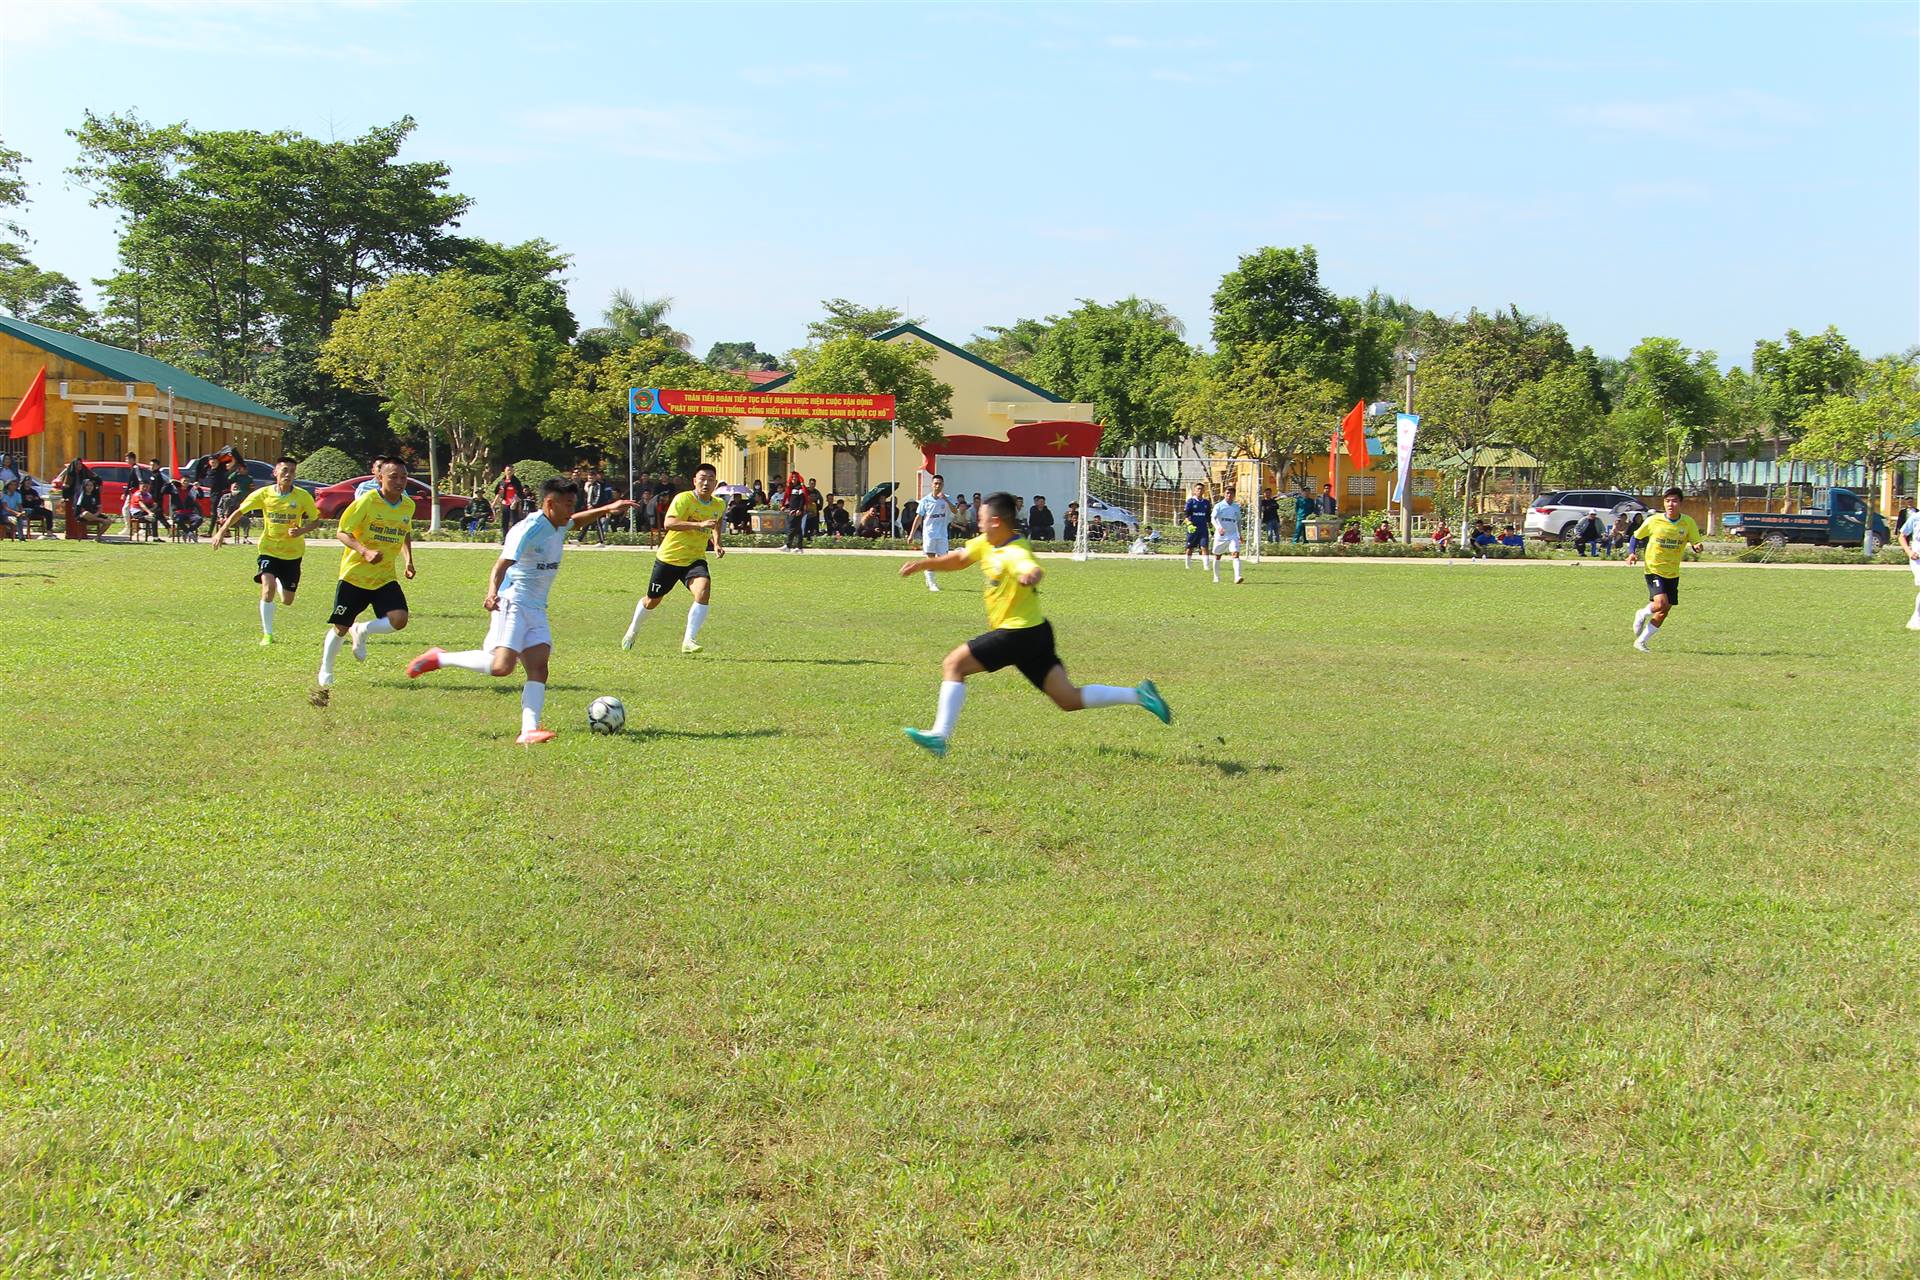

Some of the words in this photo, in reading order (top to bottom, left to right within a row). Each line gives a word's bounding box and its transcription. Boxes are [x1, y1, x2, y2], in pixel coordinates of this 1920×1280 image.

[734, 393, 747, 403] TIẾP
[687, 405, 700, 413] HUY
[651, 582, 661, 593] 17
